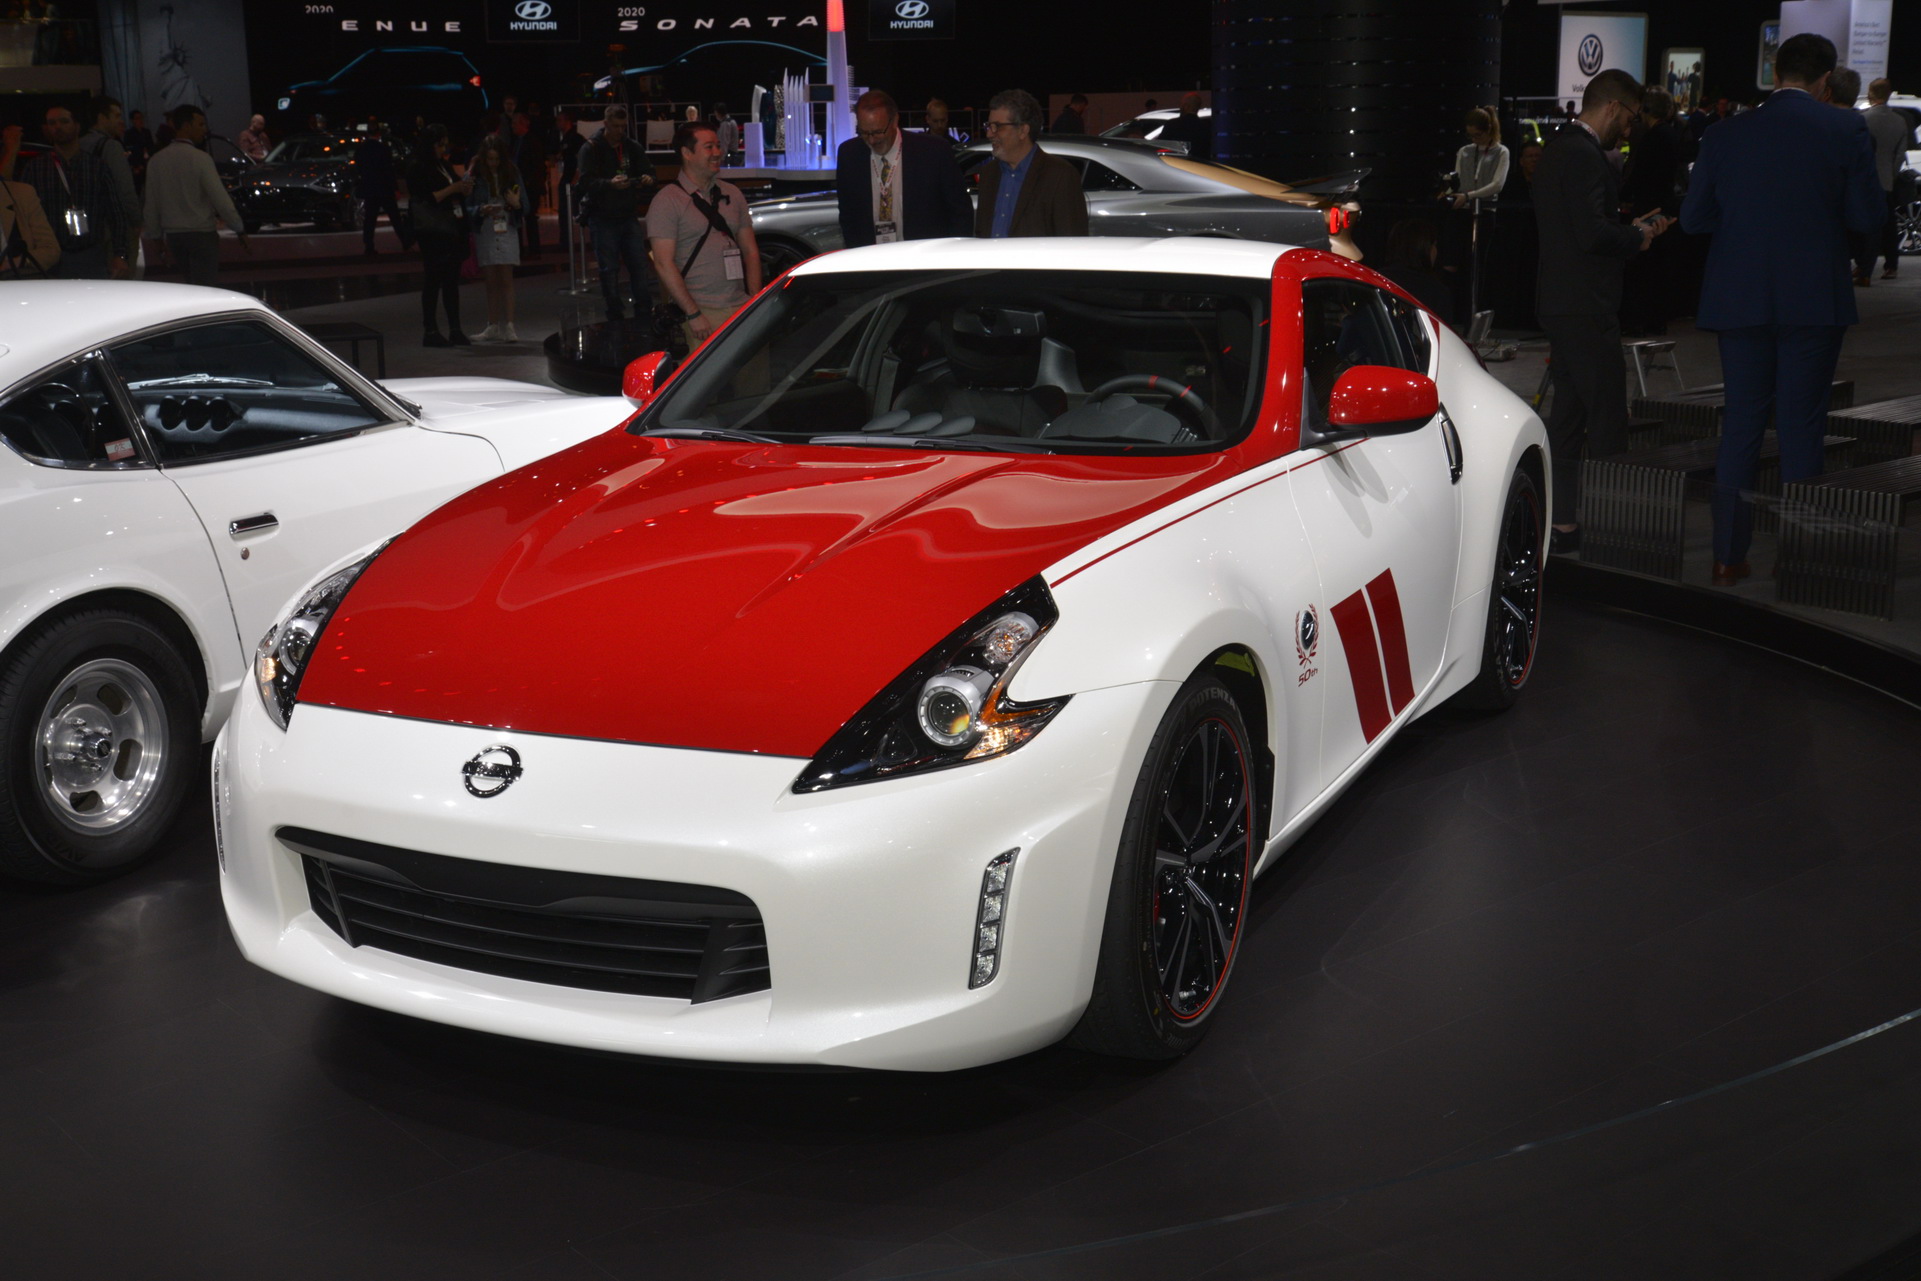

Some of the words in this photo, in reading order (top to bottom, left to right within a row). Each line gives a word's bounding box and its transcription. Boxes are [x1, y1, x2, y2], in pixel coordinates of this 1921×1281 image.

[617, 7, 646, 17] 2020
[341, 19, 461, 33] ENUE
[510, 21, 557, 31] HYUNDAI
[618, 15, 819, 31] SONATA
[889, 20, 934, 29] HYUNDAI
[1189, 687, 1236, 711] POTENZA
